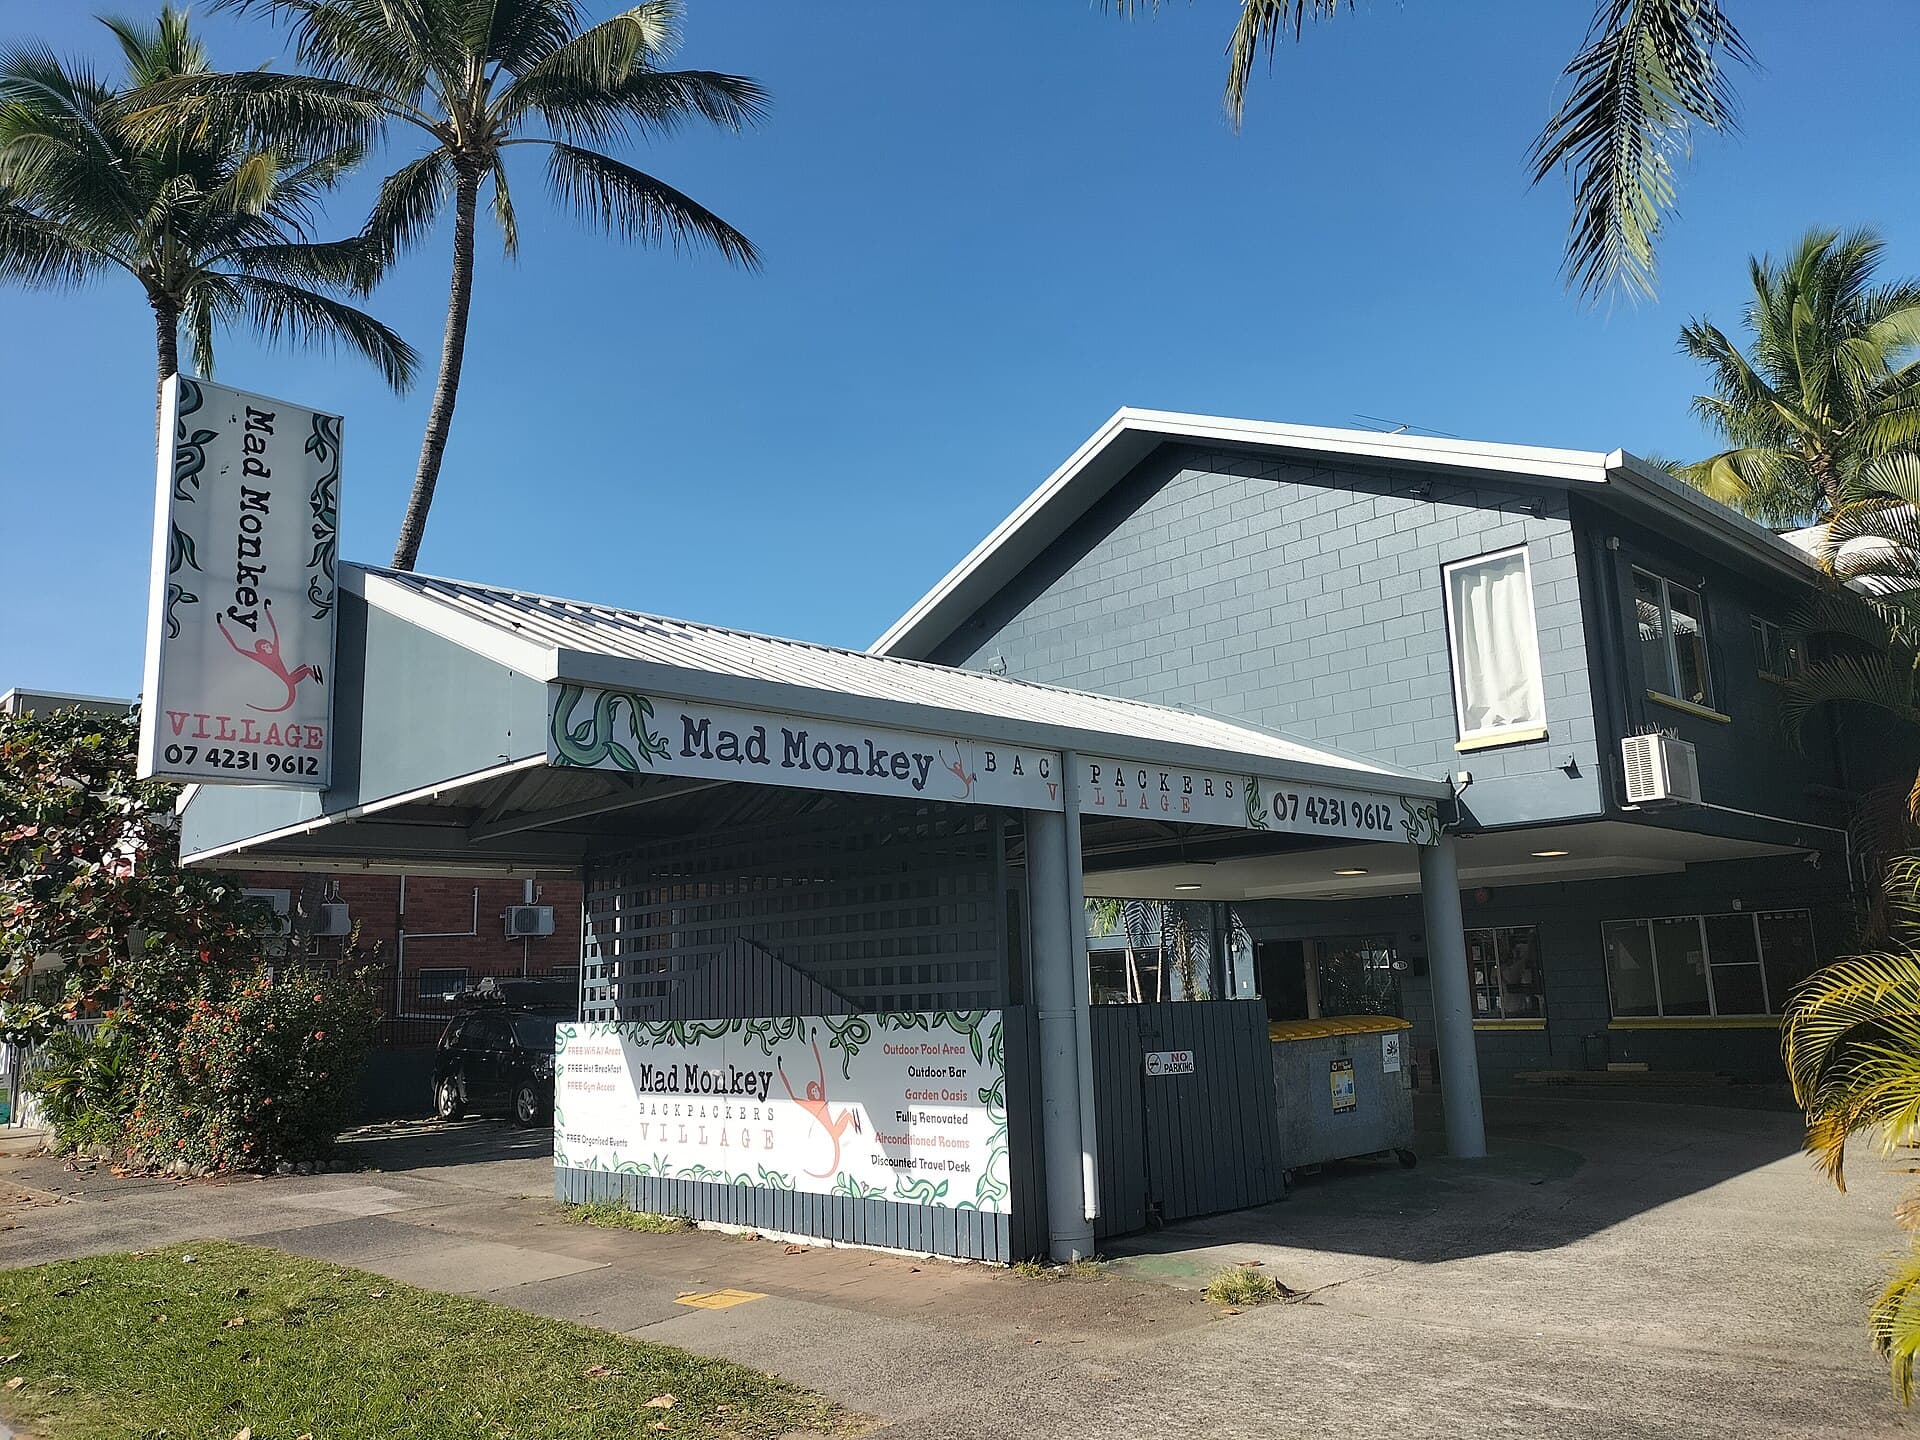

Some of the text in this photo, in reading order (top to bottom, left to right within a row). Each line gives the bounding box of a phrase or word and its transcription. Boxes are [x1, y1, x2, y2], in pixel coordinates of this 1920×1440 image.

[227, 405, 277, 632] Mad Monkey
[166, 711, 323, 749] VILLAGE
[165, 744, 319, 776] 07 4231 9612
[679, 714, 935, 791] Mad Monkey
[1046, 782, 1192, 814] VLLAGE
[1273, 792, 1393, 831] 07 4231 9612
[568, 1046, 583, 1056] FREE
[605, 1047, 621, 1056] Areas
[883, 1043, 965, 1055] Outdoor Pool Area
[1171, 1052, 1188, 1062] NO
[567, 1063, 622, 1074] FREE Hot Breakfast
[908, 1065, 966, 1078] Outdoor Bar
[1164, 1061, 1193, 1073] PARKING
[567, 1081, 615, 1093] FREE Gym Access
[639, 1062, 773, 1103] Mad Monkey
[905, 1088, 968, 1101] Garden Oasis
[640, 1102, 774, 1121] BACKPACKERS
[895, 1111, 968, 1125] Fully Renovated
[566, 1133, 581, 1143] FREE
[609, 1137, 628, 1147] Events
[640, 1122, 774, 1150] VILLAGE
[875, 1132, 970, 1149] Airconditioned Rooms
[871, 1154, 971, 1173] Discounted Travel Desk
